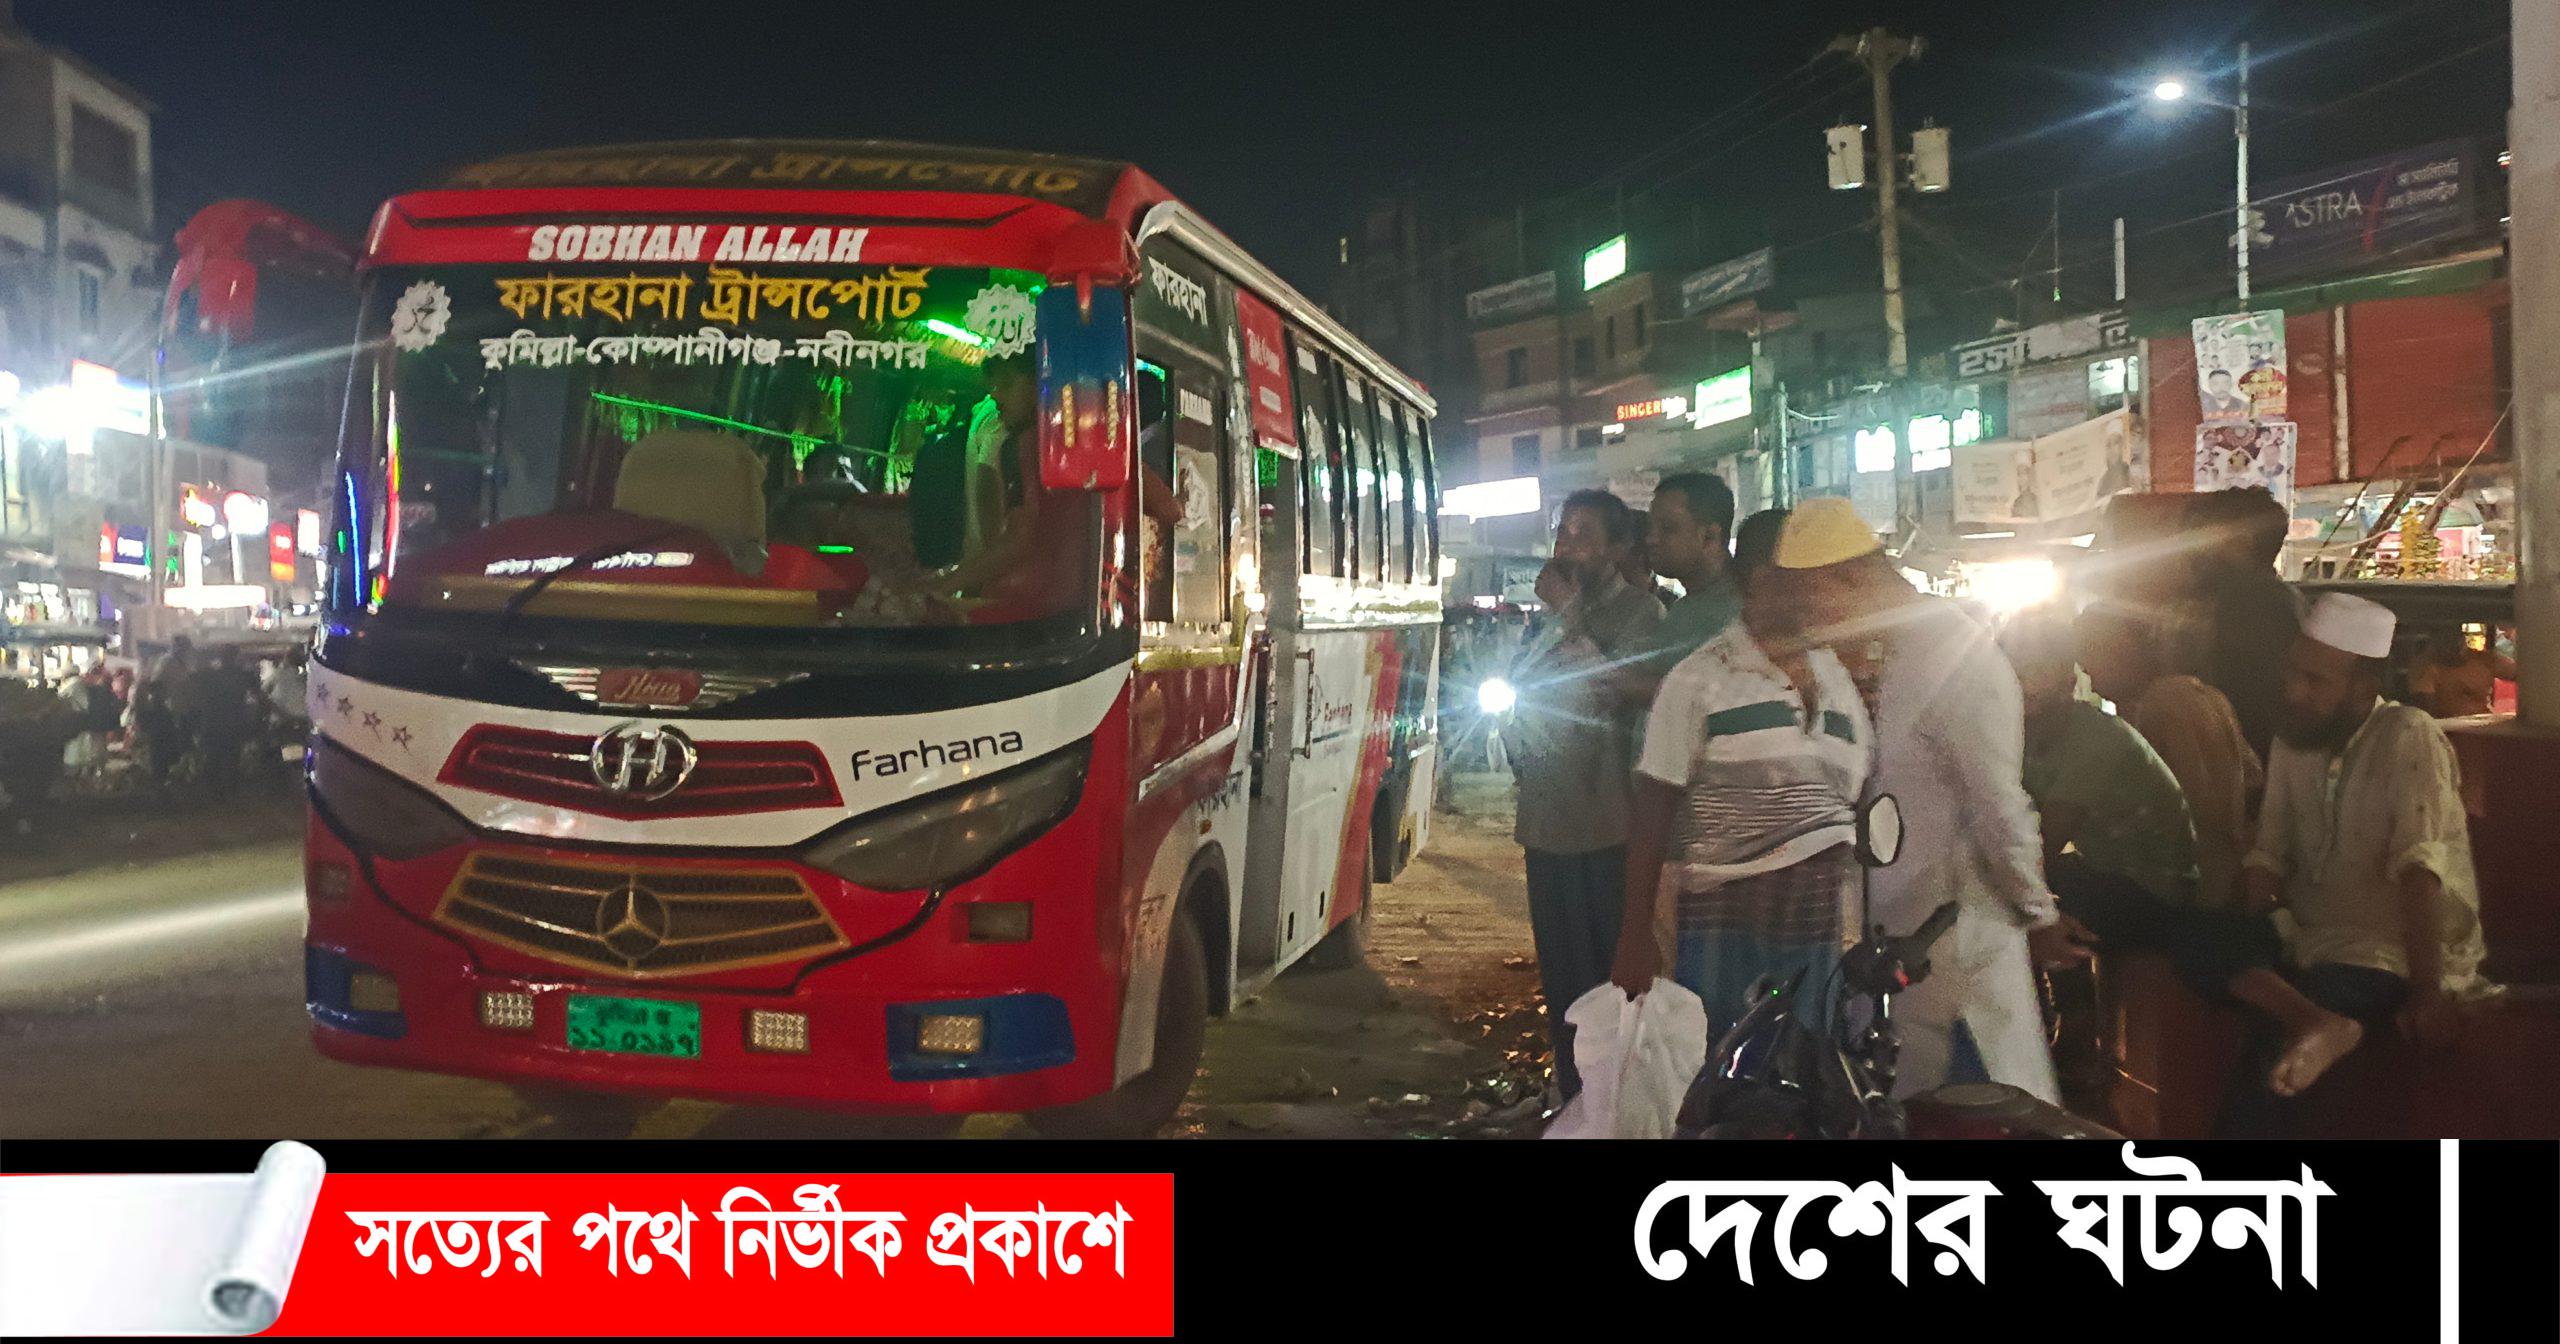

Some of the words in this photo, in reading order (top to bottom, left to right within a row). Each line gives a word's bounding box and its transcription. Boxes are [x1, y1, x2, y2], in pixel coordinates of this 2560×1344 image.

[528, 224, 706, 261] SOBHAN
[714, 226, 870, 263] ALLAH
[494, 270, 694, 322] ফারহানা
[700, 262, 932, 326] ট্রান্সপোর্ট
[1616, 400, 1662, 421] SINGER
[851, 731, 1024, 781] Farhana
